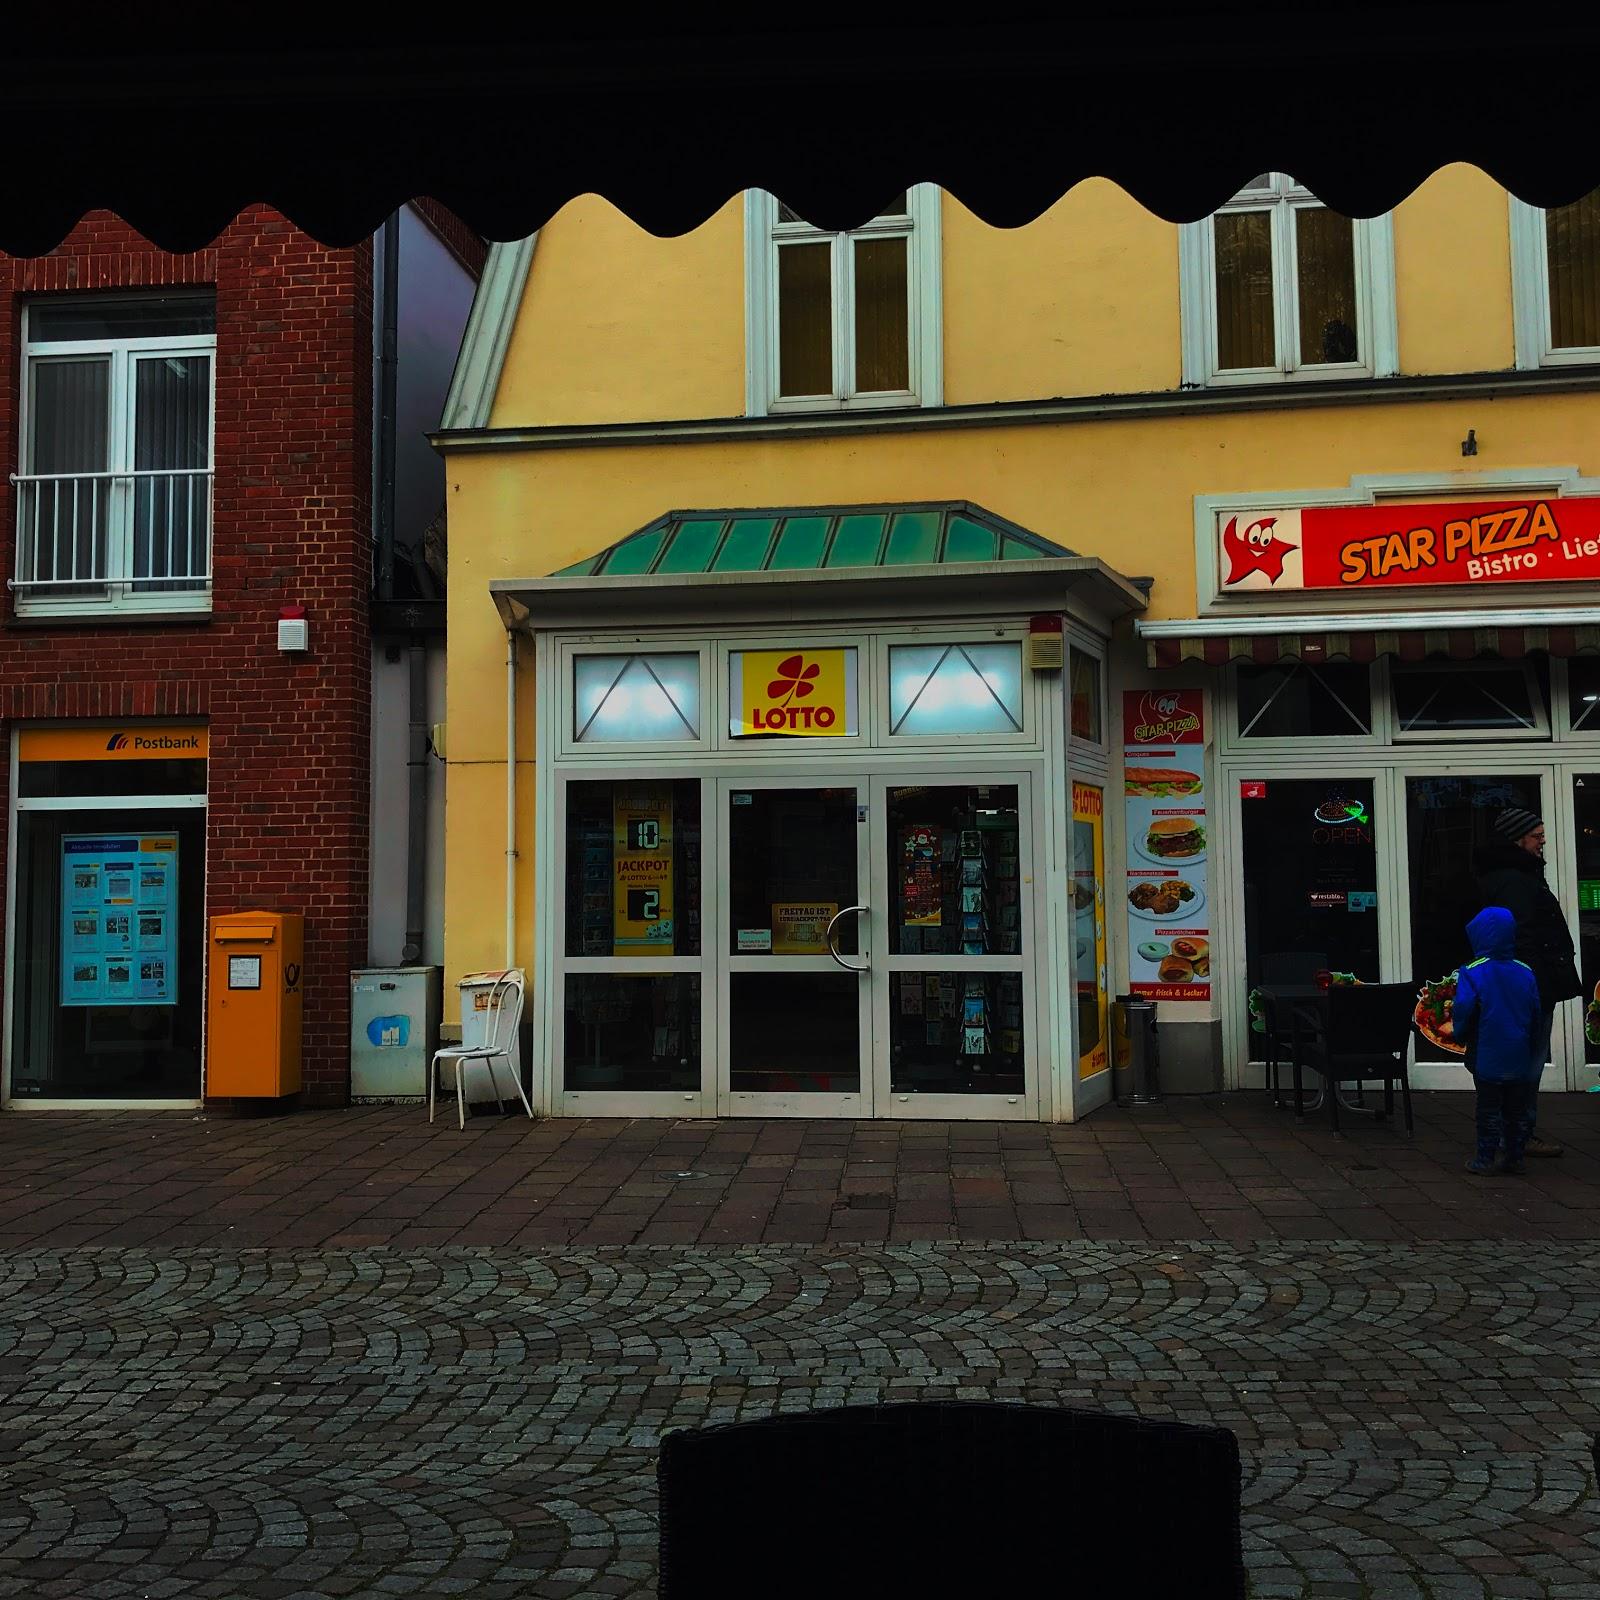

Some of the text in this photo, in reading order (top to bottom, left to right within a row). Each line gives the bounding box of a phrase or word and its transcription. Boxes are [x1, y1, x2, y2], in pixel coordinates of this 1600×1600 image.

[1341, 502, 1559, 582] STAR PIZZA
[1467, 552, 1537, 579] Bistro
[753, 706, 835, 729] LOTTO
[1136, 715, 1198, 739] STAR PIZZA
[134, 735, 199, 750] Postbank
[1079, 788, 1102, 816] LOTTO
[637, 820, 659, 849] 10
[1312, 826, 1371, 847] OPEN
[617, 859, 670, 873] JACKPOT
[643, 890, 659, 919] 2
[779, 907, 831, 916] FREITAG IST
[1155, 988, 1173, 997] frisch
[1174, 988, 1181, 997] &
